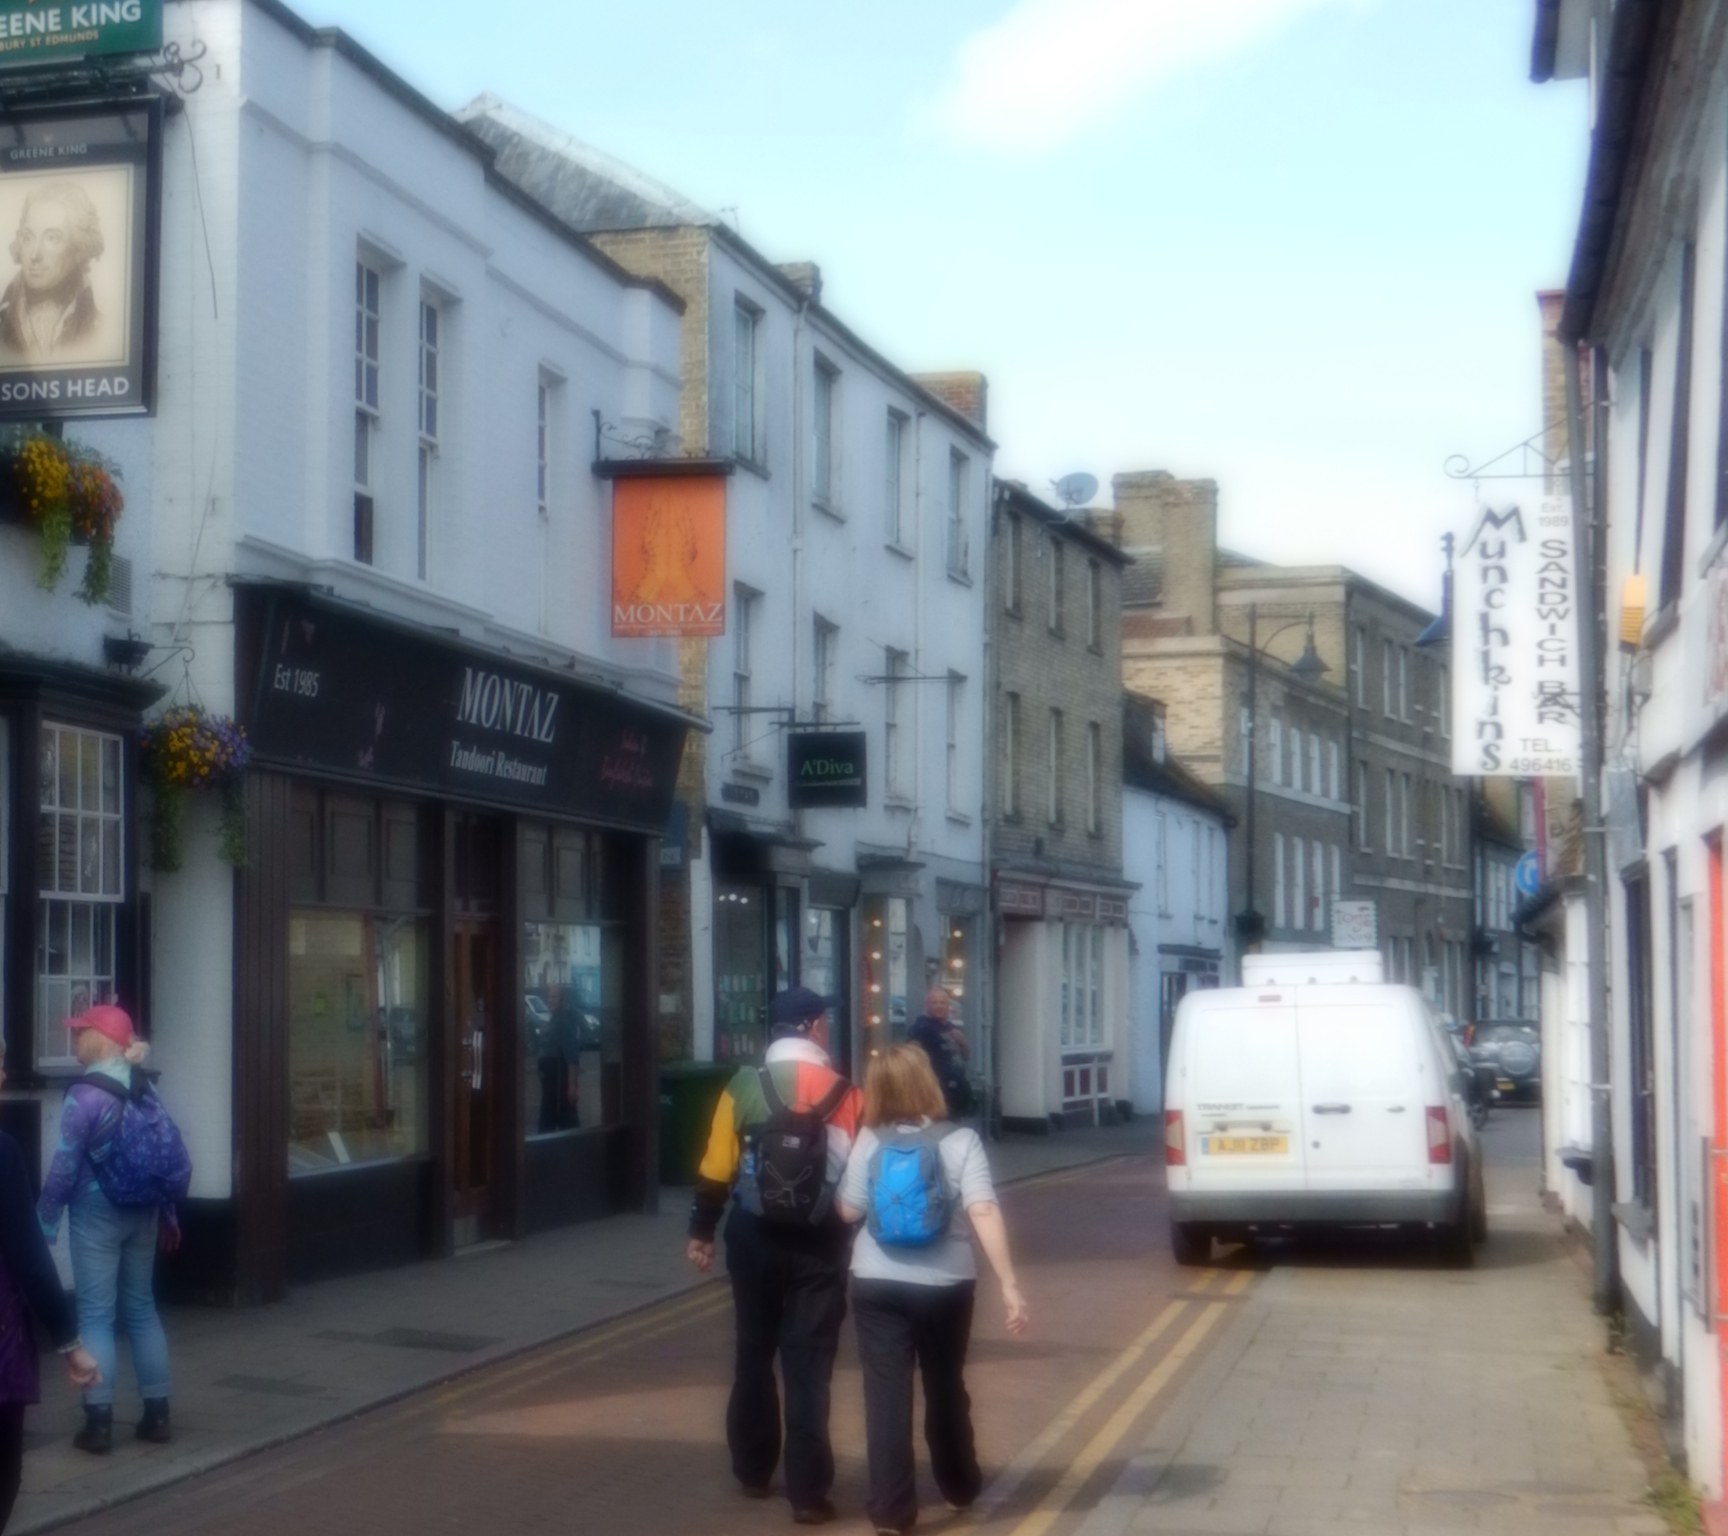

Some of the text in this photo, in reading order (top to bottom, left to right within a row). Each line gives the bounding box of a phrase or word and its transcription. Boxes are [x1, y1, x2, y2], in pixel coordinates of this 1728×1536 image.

[29, 37, 41, 49] ST
[45, 30, 100, 47] EDMUNDS
[10, 144, 88, 161] GREENE KING
[67, 376, 130, 398] HEAD
[1538, 515, 1569, 528] 1989
[614, 602, 723, 623] MONTAZ
[1536, 539, 1570, 667] SANDWICH
[1460, 502, 1528, 772] Munchkins
[274, 664, 321, 698] Est 1985
[456, 666, 560, 743] MONTAZ
[1519, 737, 1562, 754] TEL.
[450, 740, 548, 786] Tandoori Restaurant
[800, 758, 854, 776] A'Diva
[1509, 758, 1572, 773] 496416
